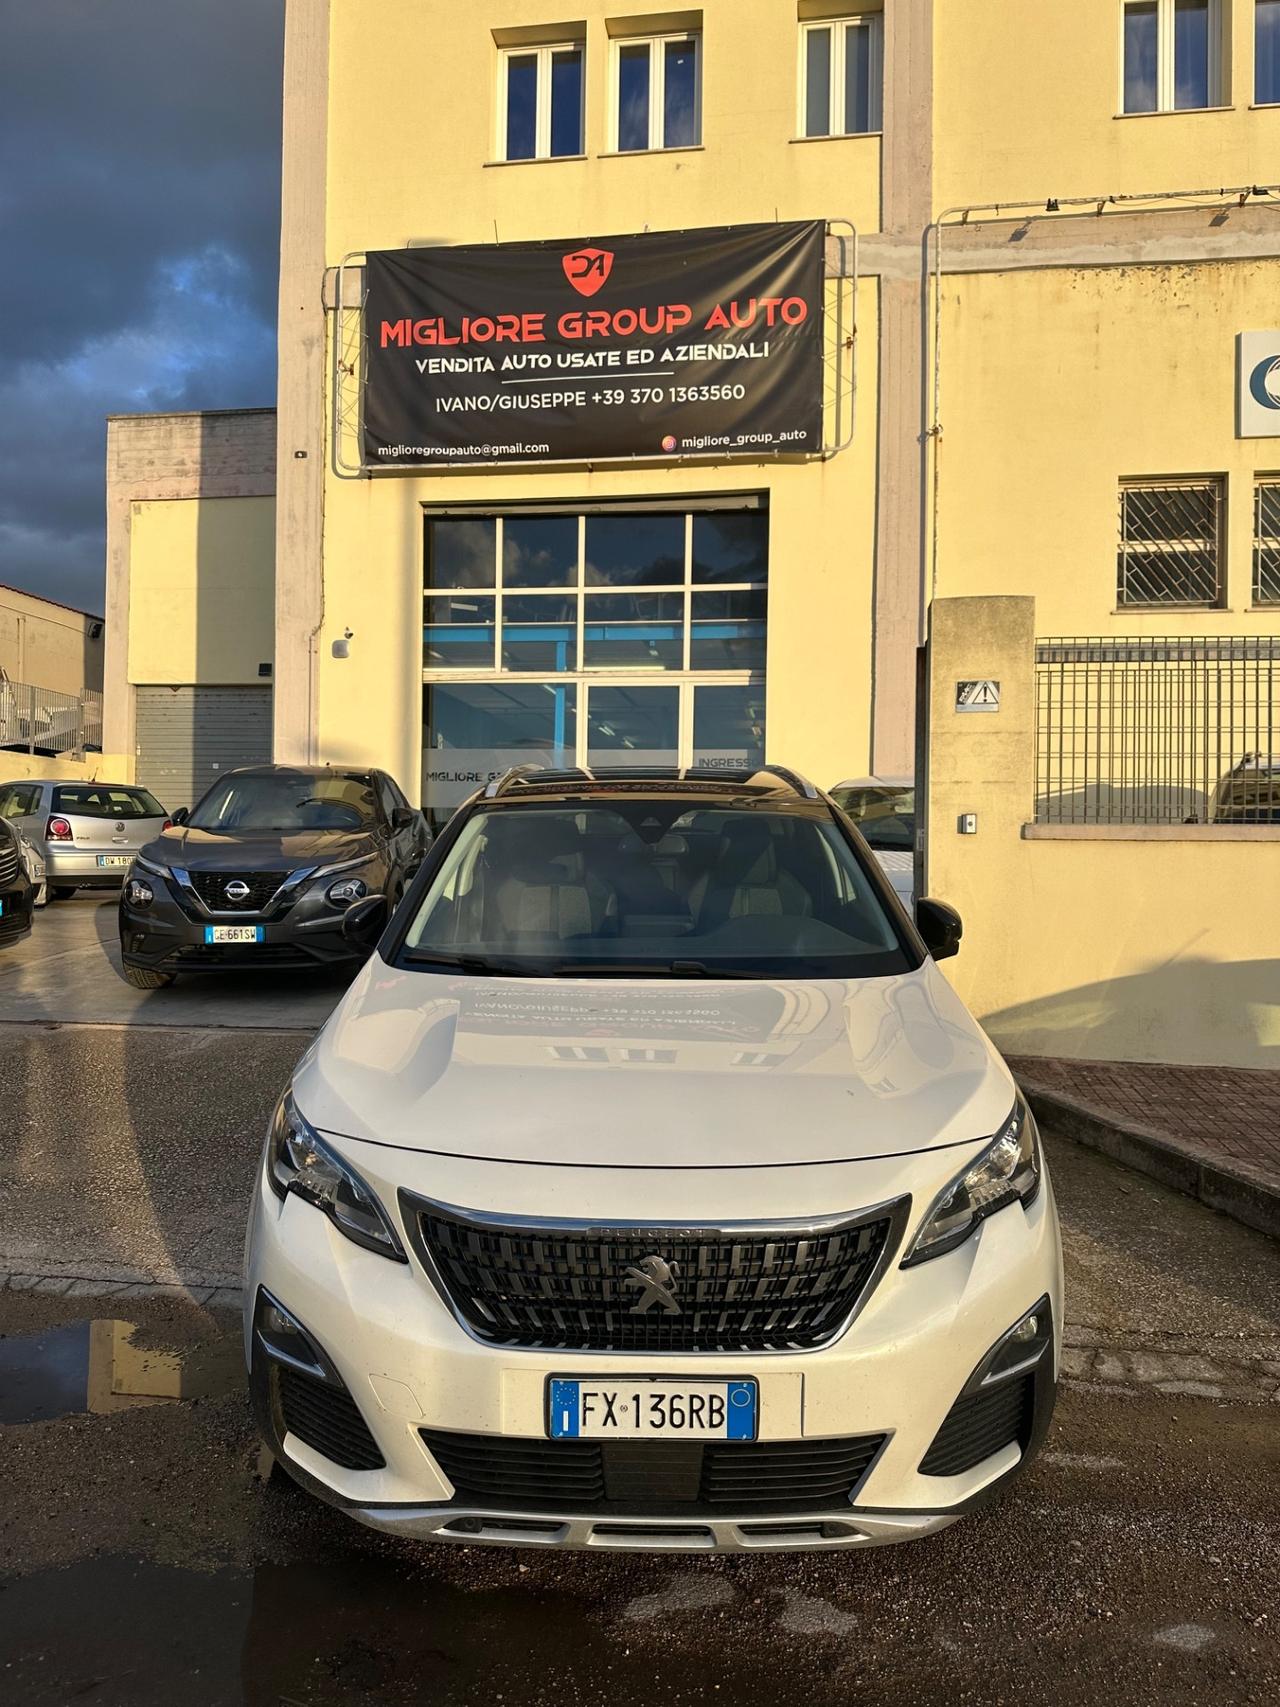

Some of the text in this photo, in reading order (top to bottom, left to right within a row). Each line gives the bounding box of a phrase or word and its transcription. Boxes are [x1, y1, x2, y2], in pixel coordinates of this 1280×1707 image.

[380, 297, 808, 348] MIGLIORE GROUP AUTO
[415, 341, 769, 375] VENDITA AUTO USATE ED AZIENDALI
[436, 384, 746, 412] IVANO/GIUSEPPE +39 370 1363560
[378, 443, 550, 457] miglioregroupauto@gmail.com
[681, 430, 807, 449] migliore_group_auto
[426, 771, 482, 782] MIGLIORE
